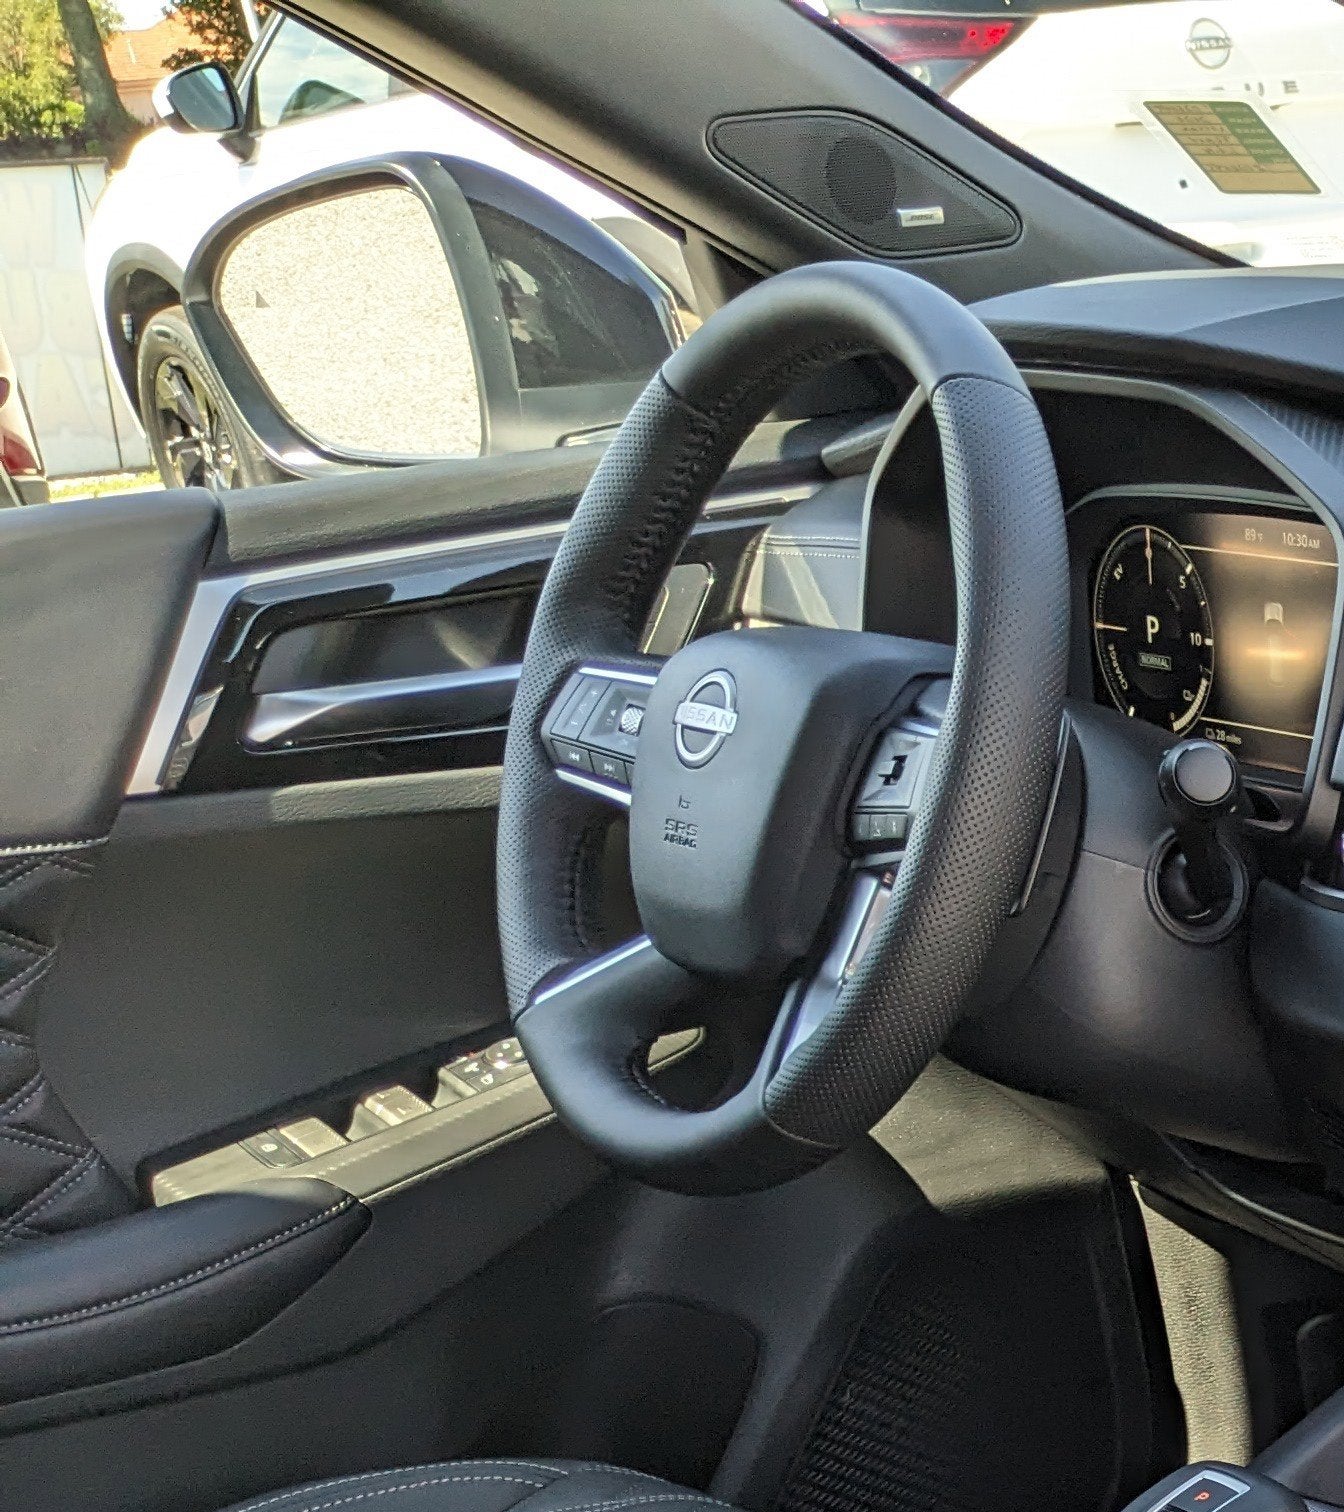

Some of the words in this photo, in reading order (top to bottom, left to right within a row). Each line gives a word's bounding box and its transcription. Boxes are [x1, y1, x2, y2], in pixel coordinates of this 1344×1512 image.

[1146, 615, 1160, 643] P
[1190, 632, 1202, 647] 10
[681, 706, 734, 729] ISSAN
[665, 818, 699, 836] SRS
[663, 833, 697, 849] AIRBAG
[1193, 1491, 1210, 1501] P
